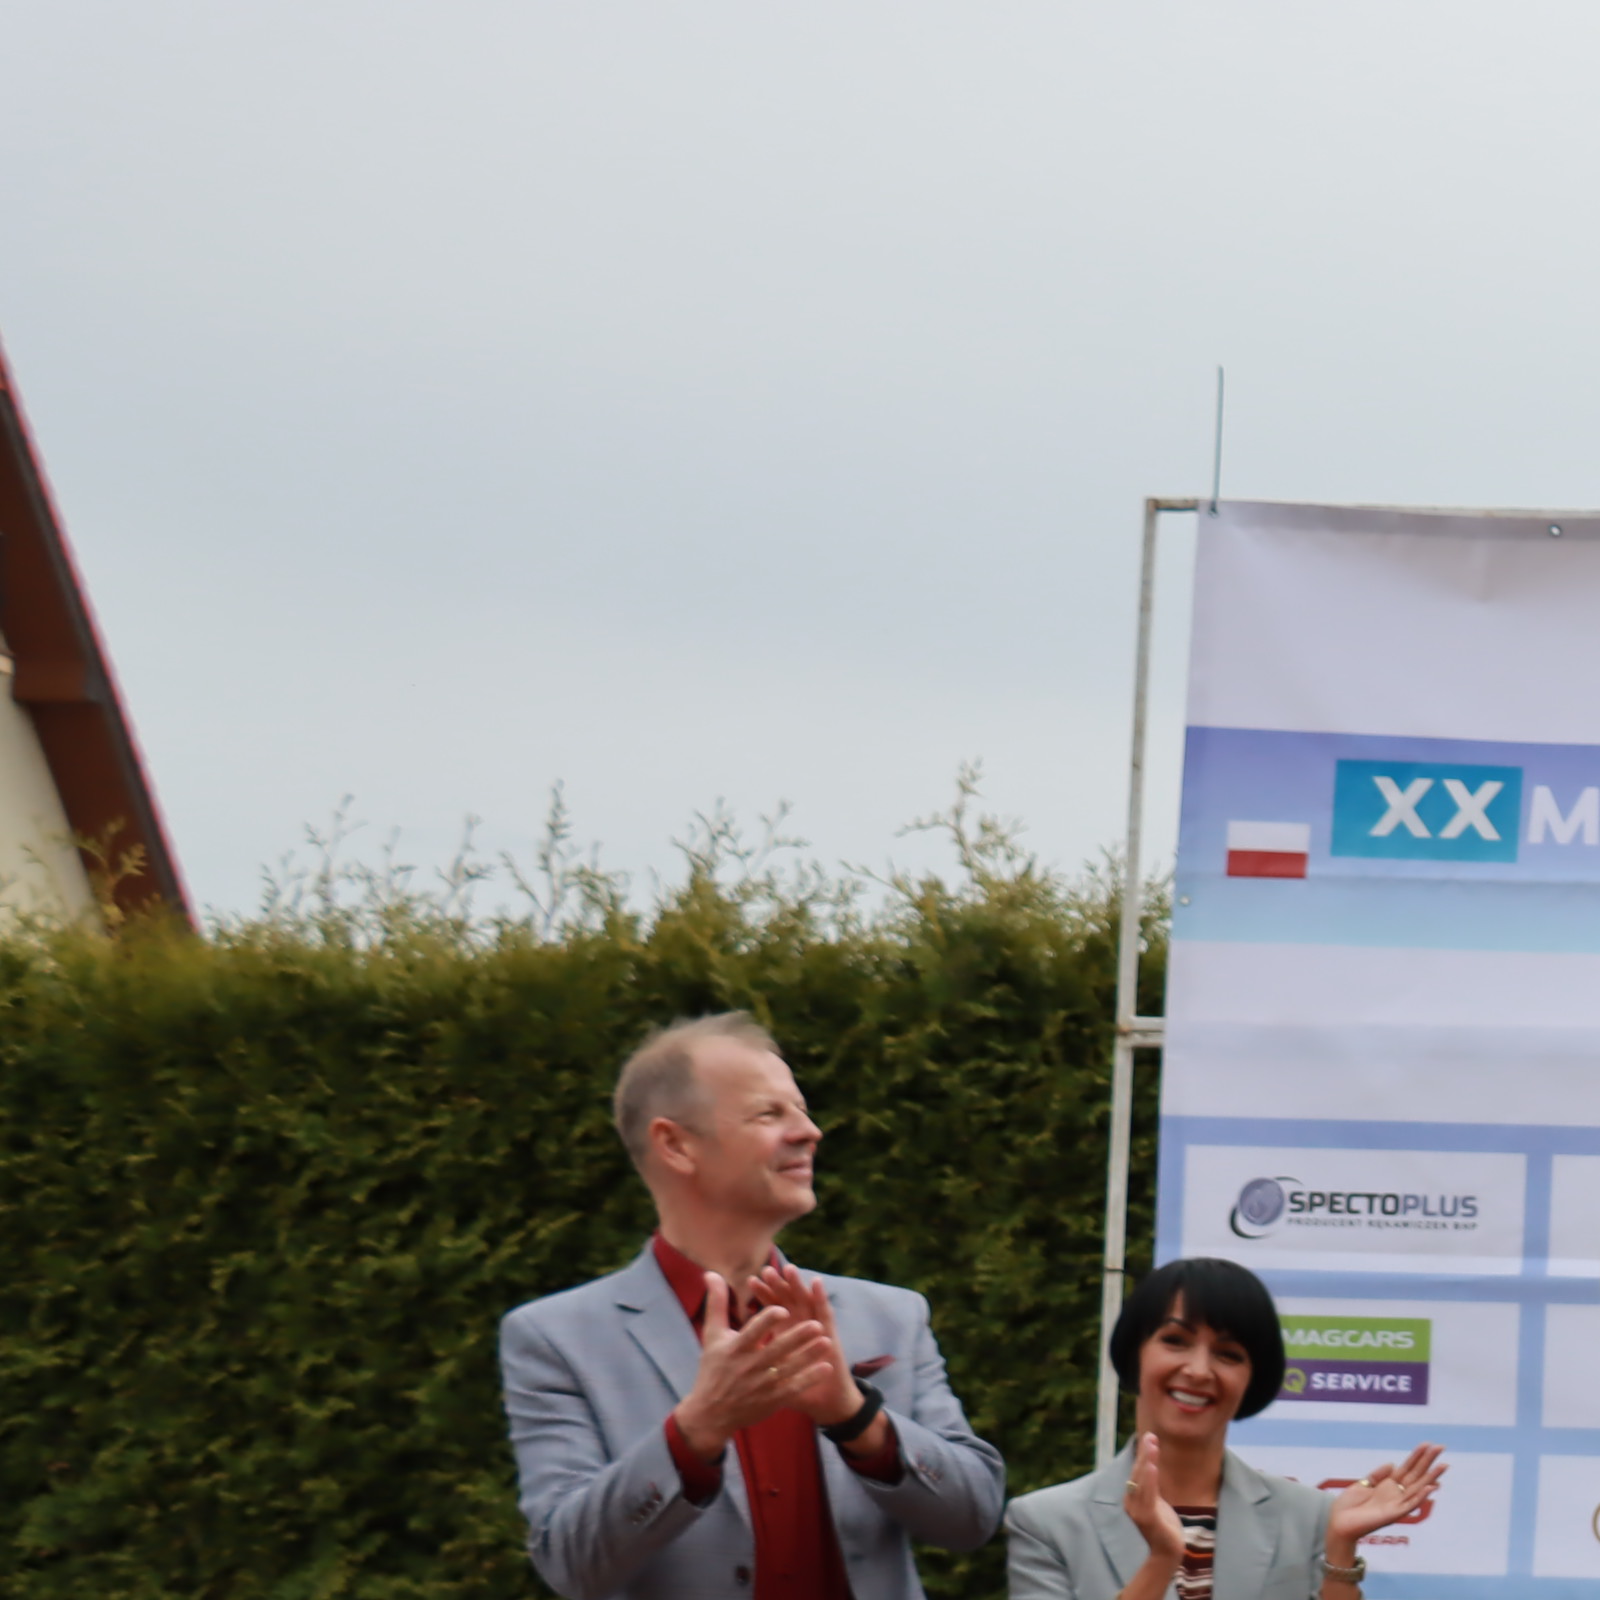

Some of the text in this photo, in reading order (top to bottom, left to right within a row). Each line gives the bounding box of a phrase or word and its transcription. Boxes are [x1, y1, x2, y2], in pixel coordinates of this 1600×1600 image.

[1369, 776, 1504, 840] XX
[1289, 1191, 1479, 1218] SPECTOPLUS
[1311, 1371, 1412, 1393] SERVICE
